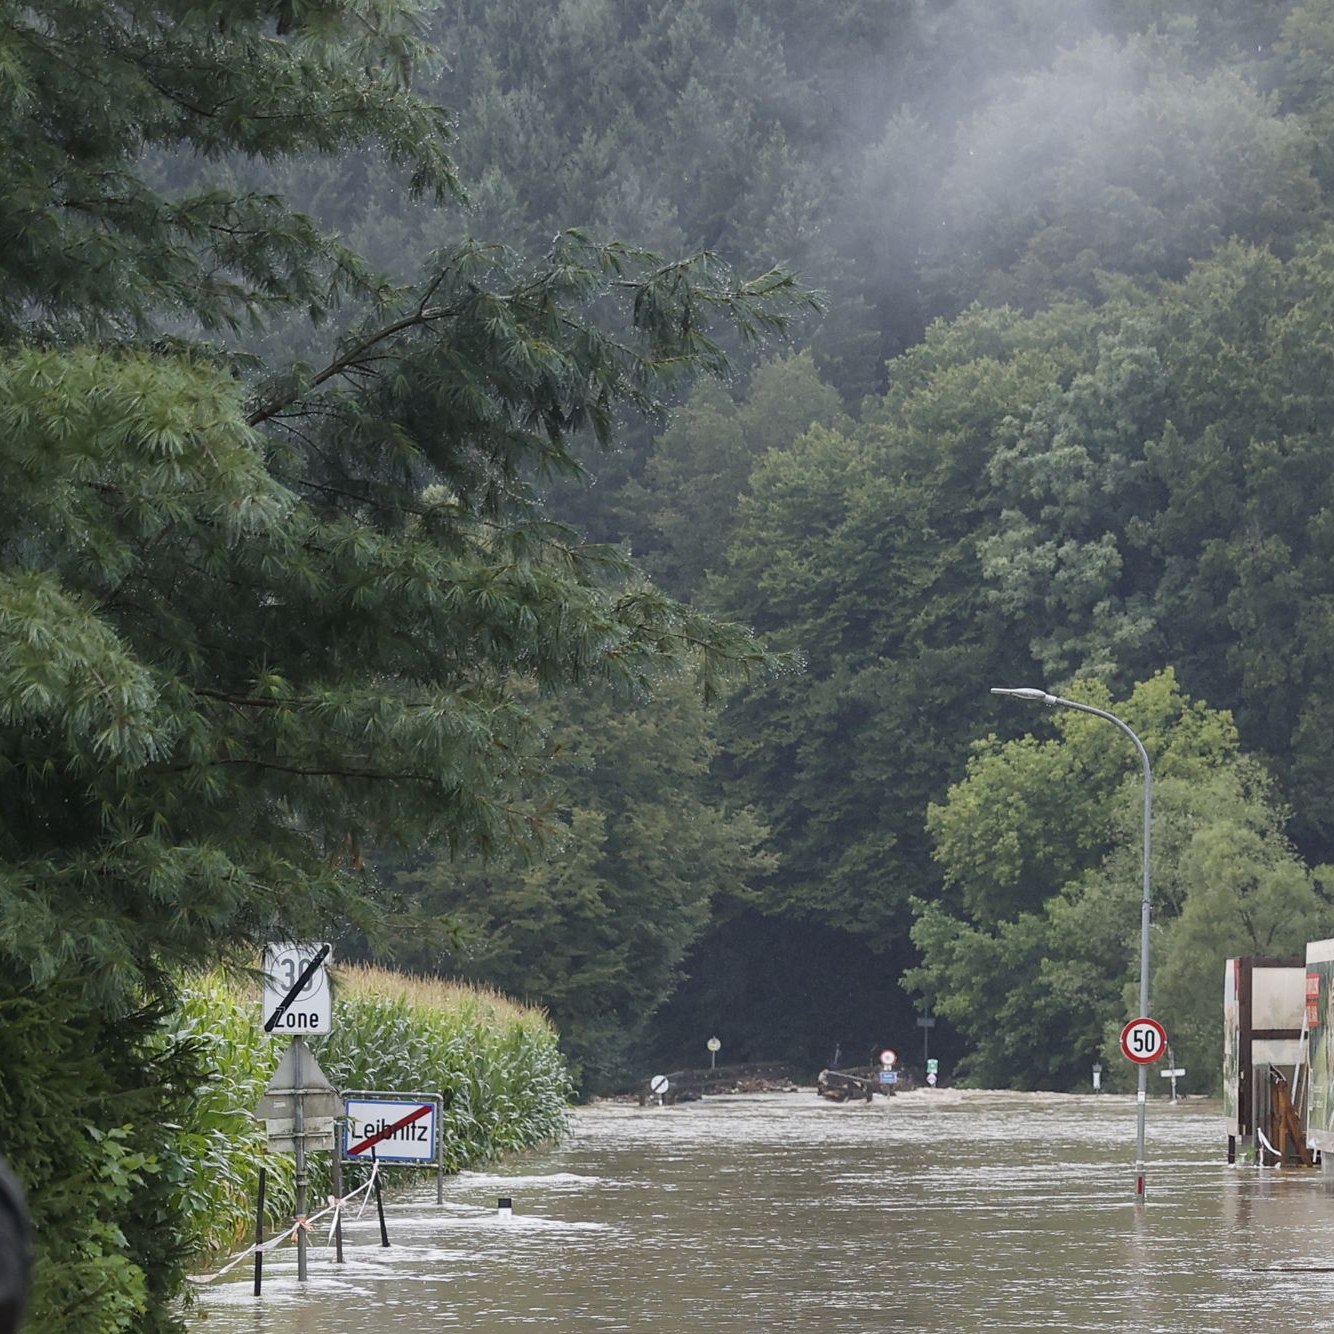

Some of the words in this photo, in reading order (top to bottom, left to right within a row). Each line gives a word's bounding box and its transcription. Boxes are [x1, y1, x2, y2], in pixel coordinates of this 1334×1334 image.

[280, 958, 313, 992] 30
[275, 1009, 319, 1028] Zone
[1133, 1029, 1155, 1052] 50
[352, 1118, 428, 1142] Leibnitz
